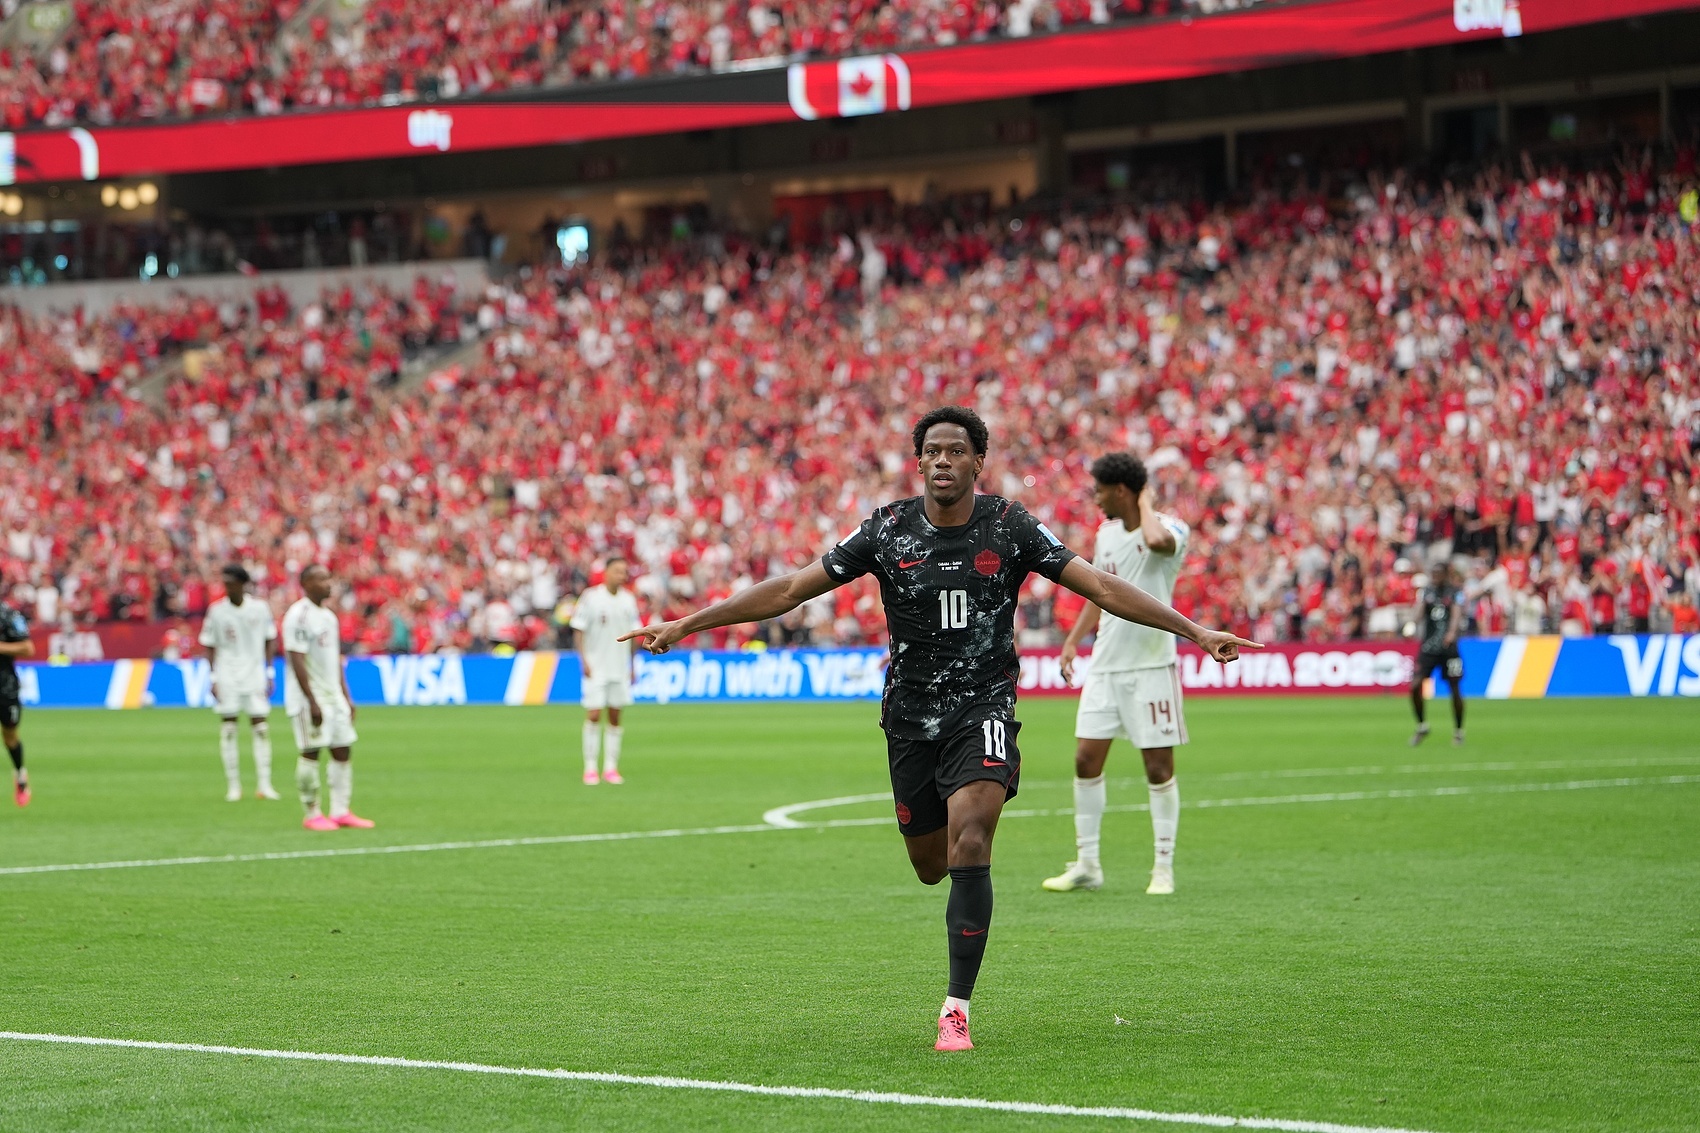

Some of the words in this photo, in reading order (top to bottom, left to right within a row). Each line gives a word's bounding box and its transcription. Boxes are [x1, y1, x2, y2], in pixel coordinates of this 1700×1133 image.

[938, 590, 967, 629] 10
[374, 655, 467, 705] VISA
[686, 650, 722, 698] in
[724, 649, 802, 698] with
[805, 652, 886, 697] VISA
[1149, 700, 1171, 725] 14
[982, 720, 1006, 760] 10
